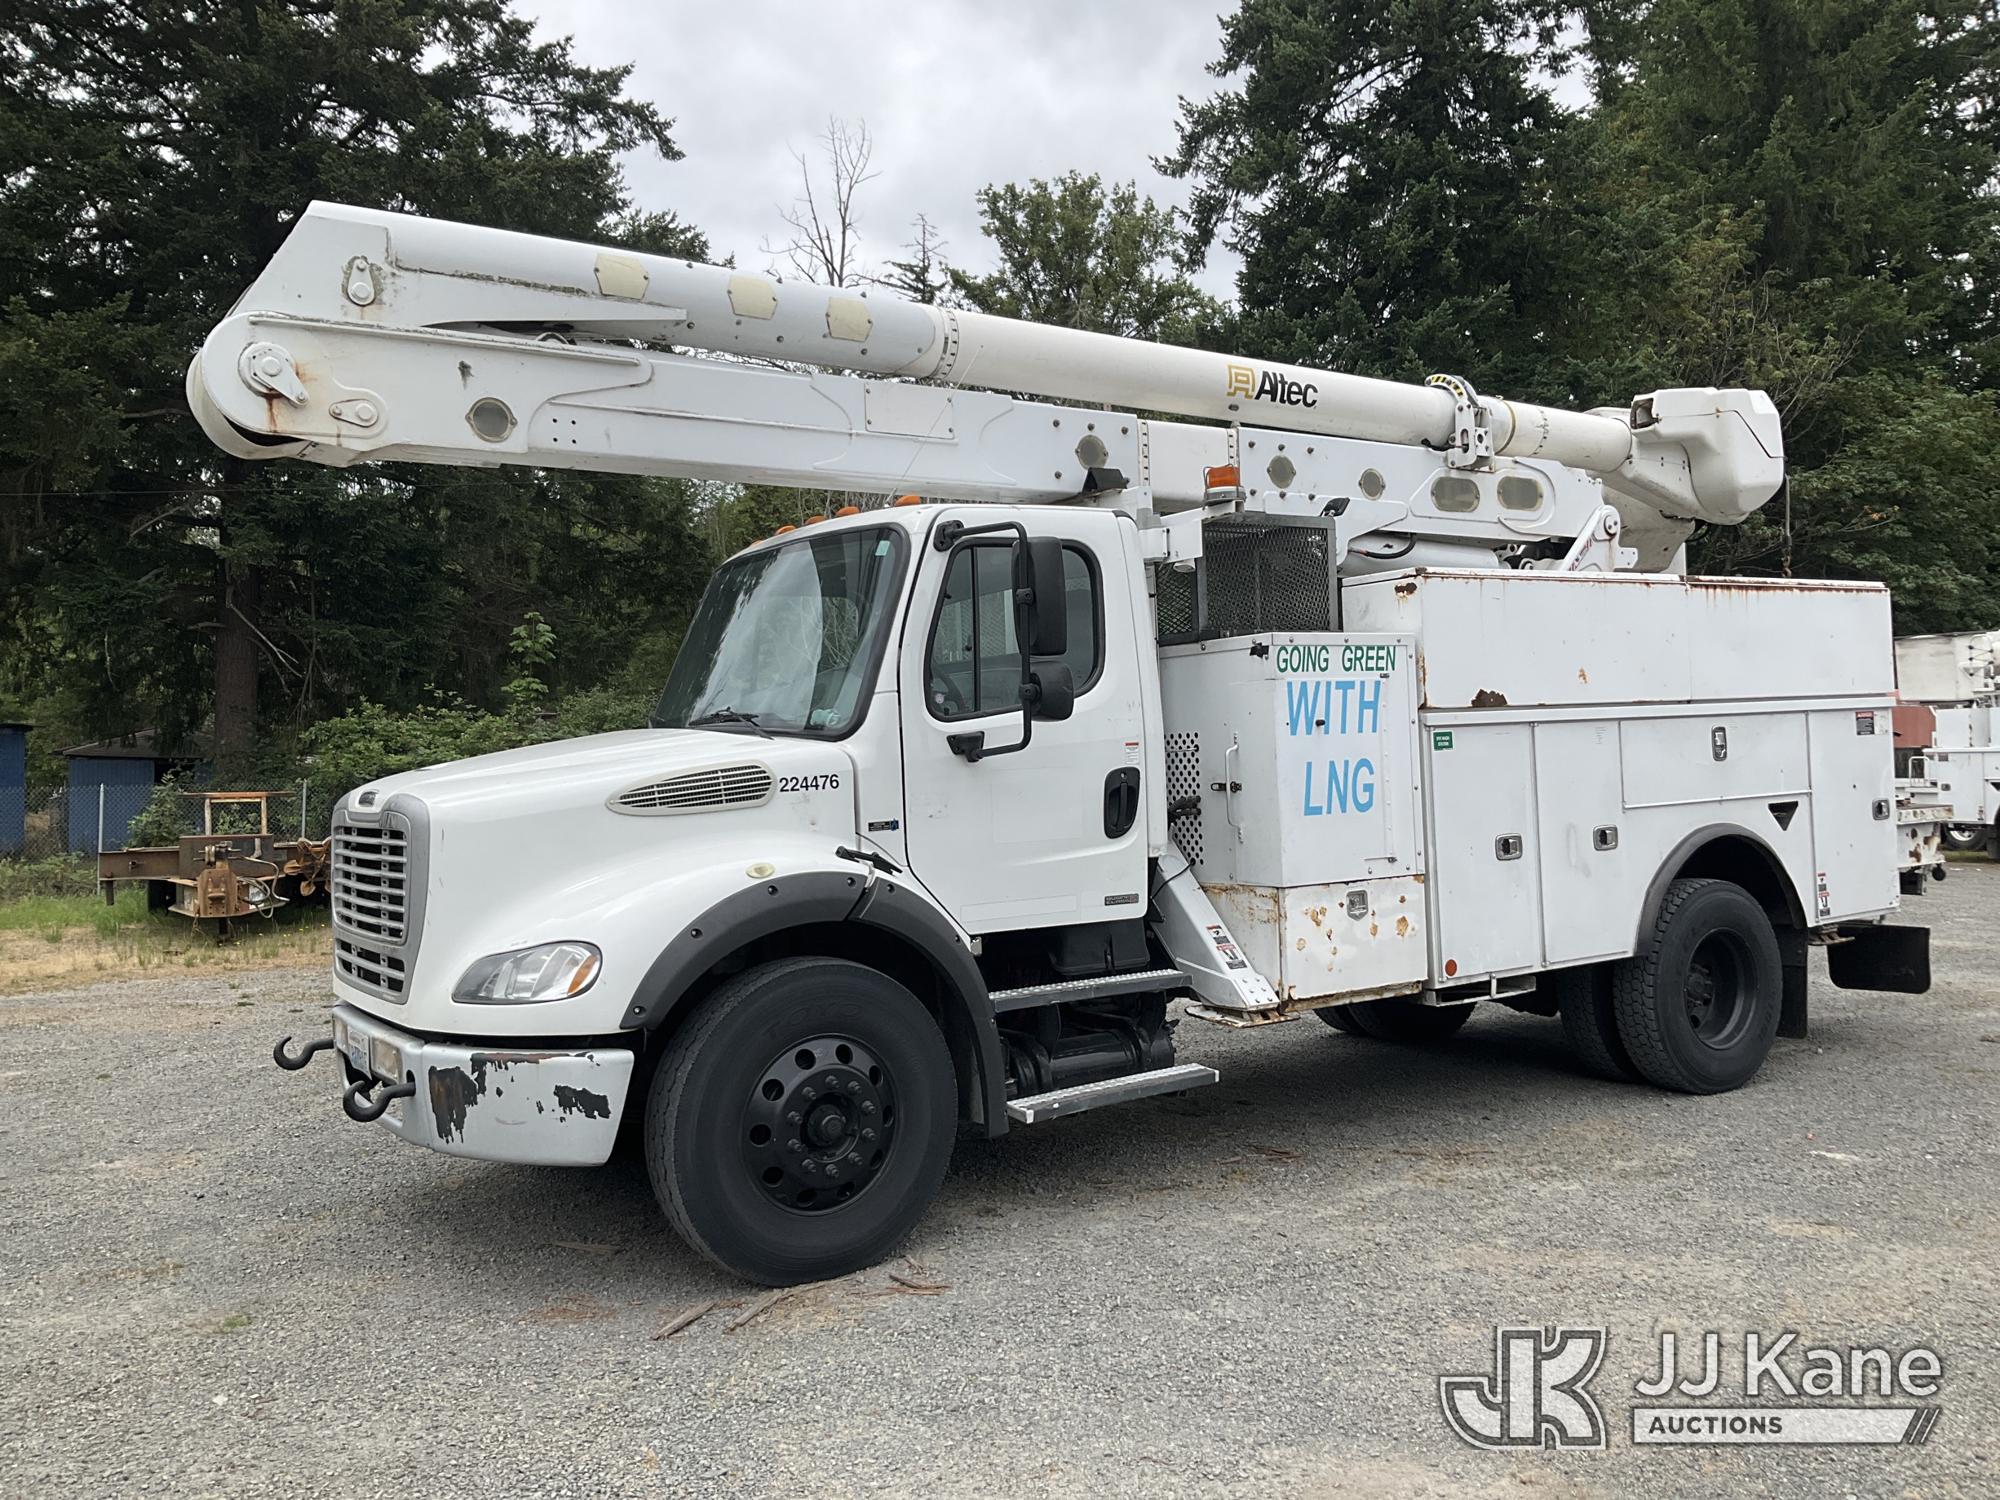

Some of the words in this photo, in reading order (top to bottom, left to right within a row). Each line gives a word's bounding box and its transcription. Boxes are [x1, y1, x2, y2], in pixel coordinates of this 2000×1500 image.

[1254, 370, 1318, 408] Altec
[1276, 645, 1329, 673] GOING
[1341, 645, 1396, 672] GREEN
[1286, 680, 1381, 736] WITH
[779, 774, 840, 793] 224476
[1303, 758, 1375, 816] LNG
